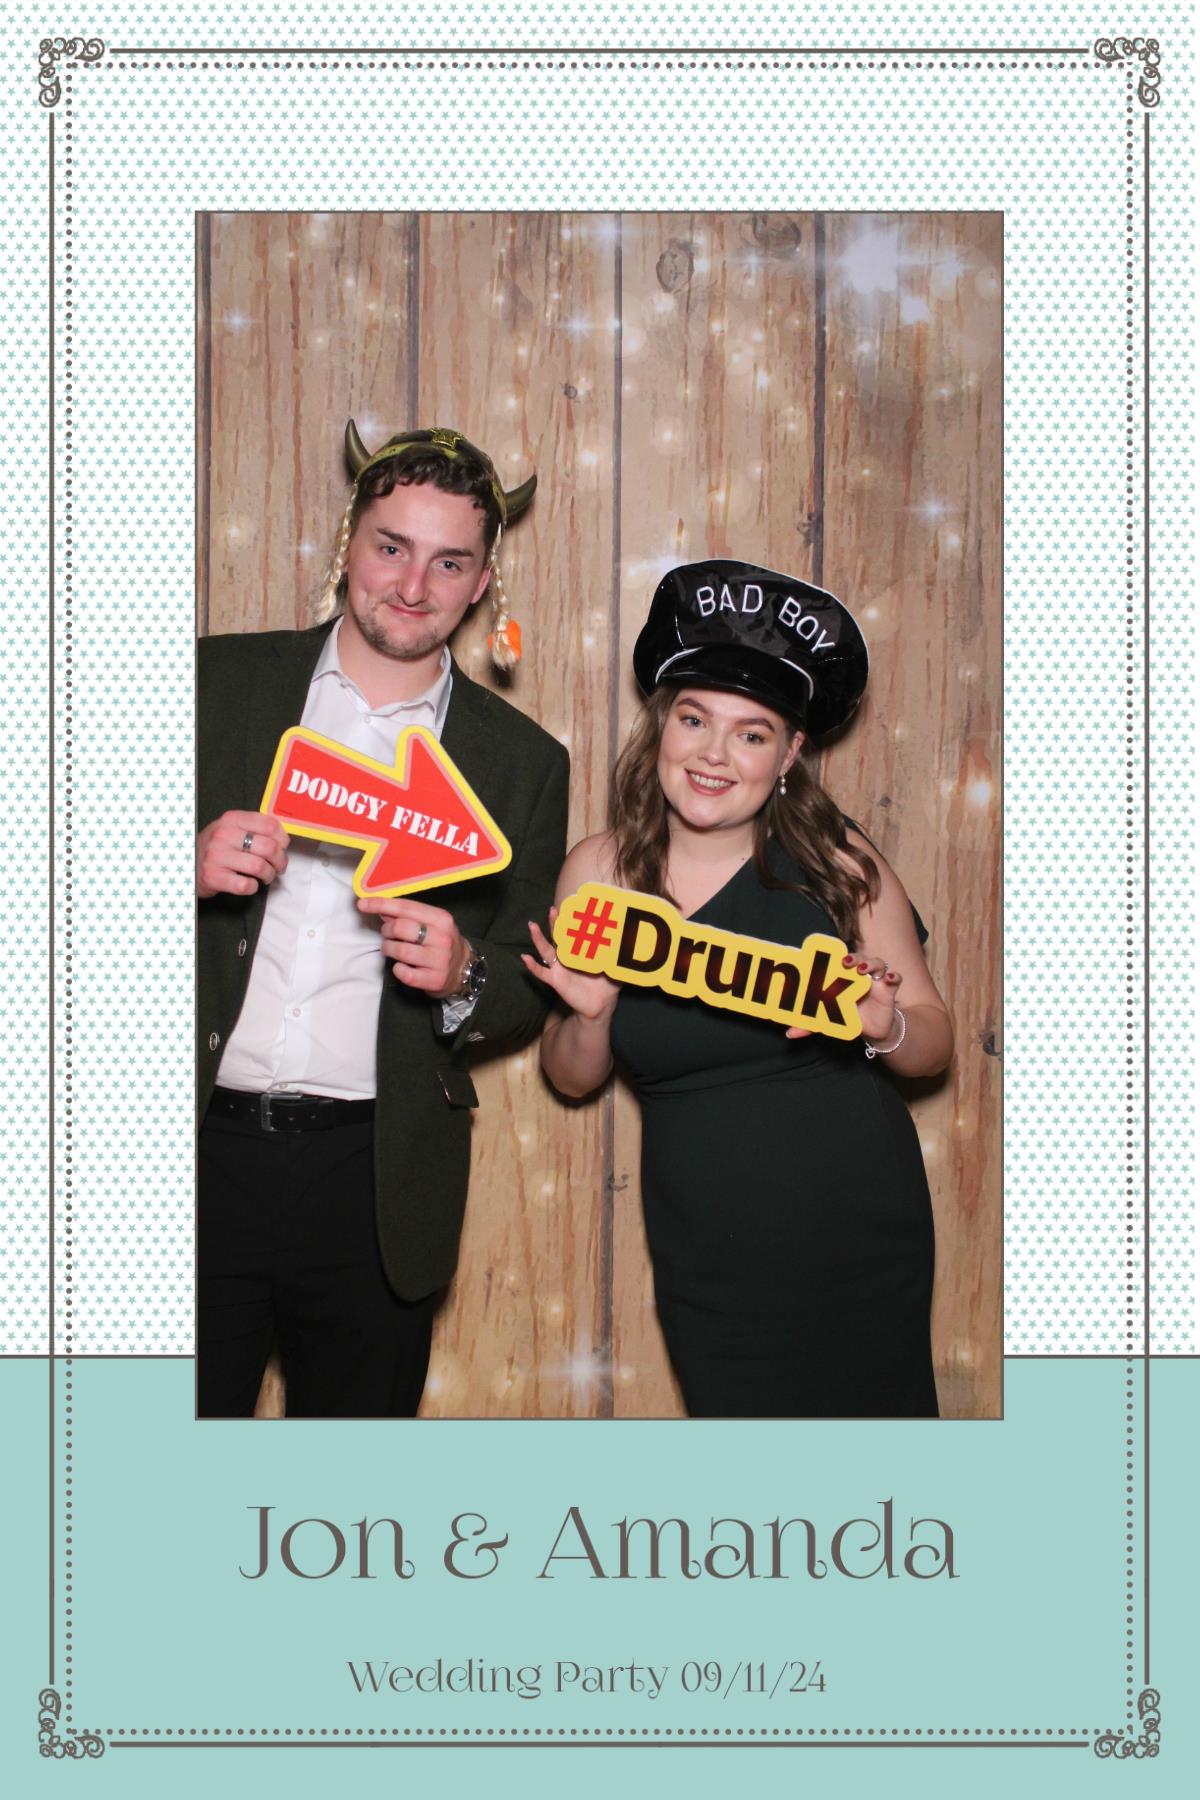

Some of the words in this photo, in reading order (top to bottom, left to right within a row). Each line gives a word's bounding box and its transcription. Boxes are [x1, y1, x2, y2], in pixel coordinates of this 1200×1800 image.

[696, 583, 764, 617] BAD
[777, 596, 836, 654] BOY
[287, 768, 388, 822] DODGY
[389, 805, 480, 857] FELLA
[566, 896, 856, 1027] #Drunk
